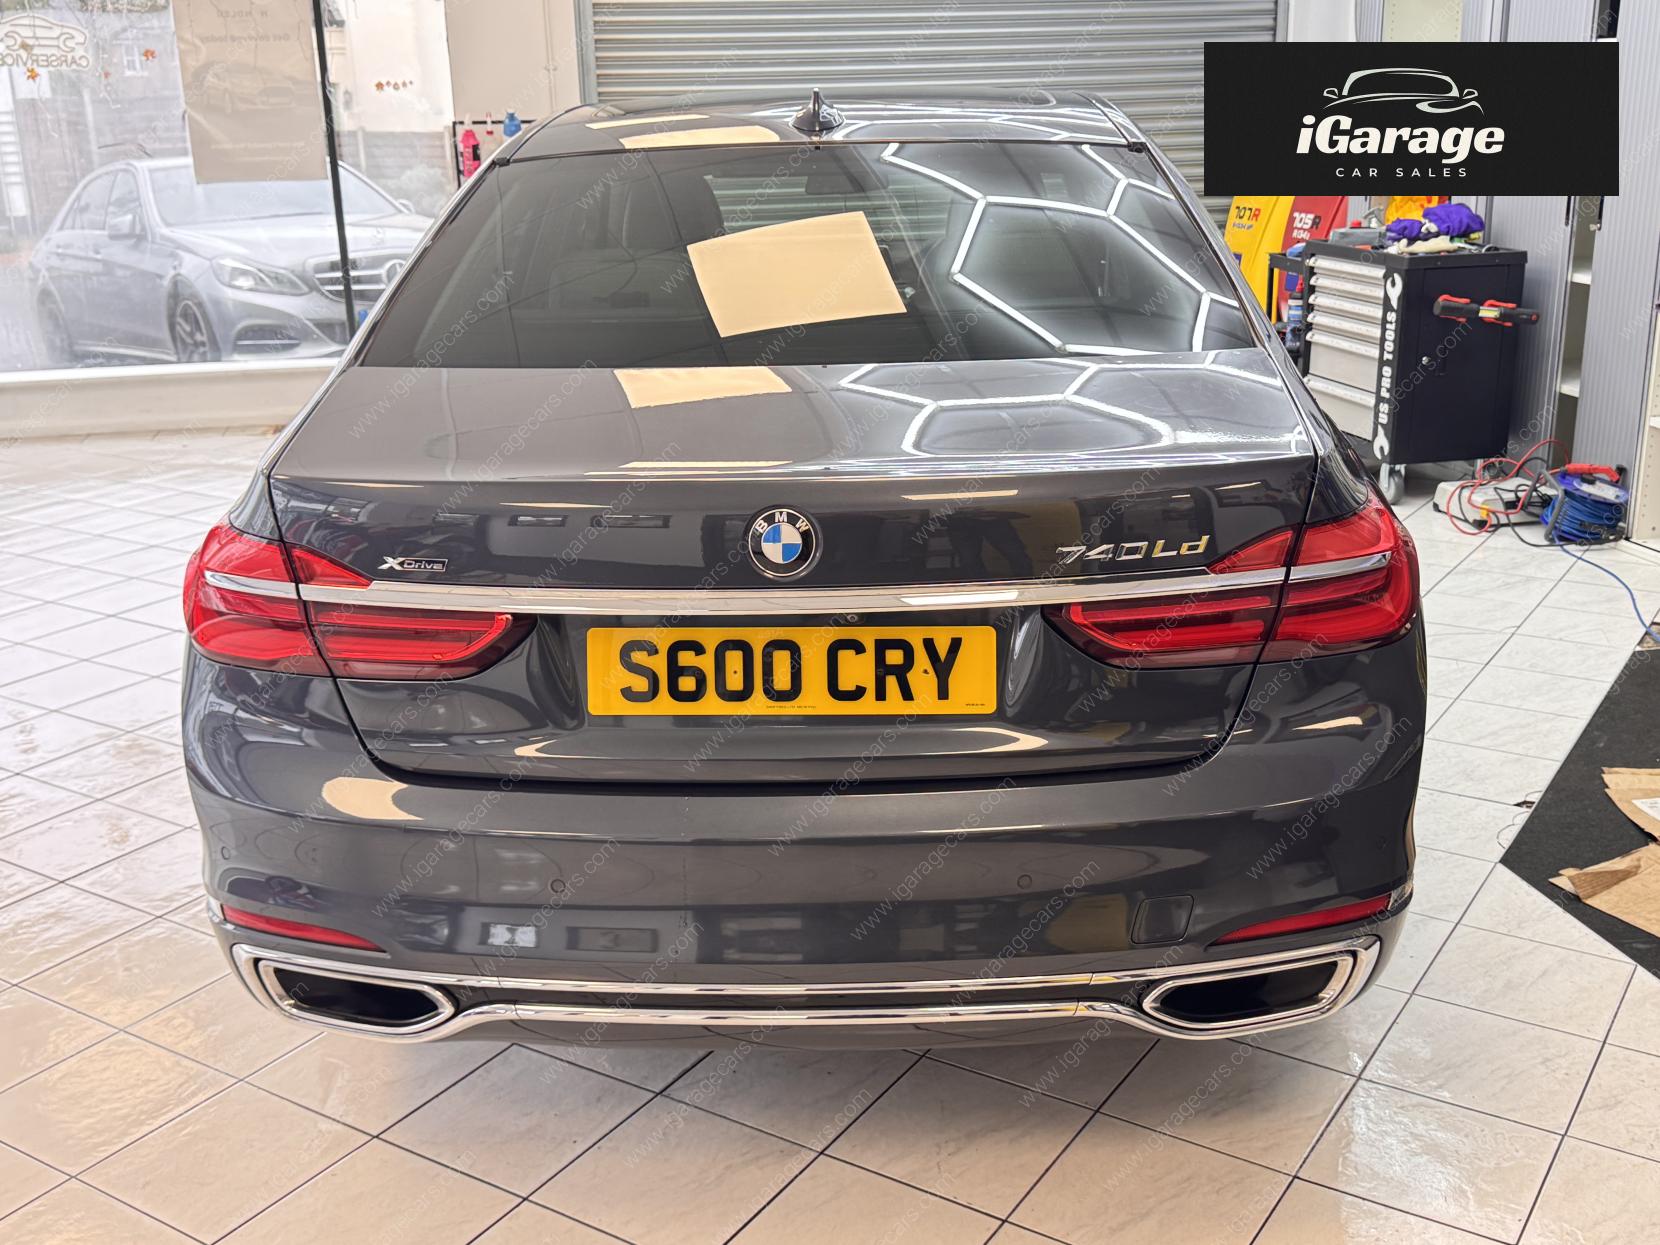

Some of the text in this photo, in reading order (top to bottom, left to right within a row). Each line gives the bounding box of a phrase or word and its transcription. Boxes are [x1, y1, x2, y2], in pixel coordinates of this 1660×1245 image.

[1378, 311, 1397, 425] US PRO TOOLS
[755, 511, 810, 534] BMW
[619, 637, 963, 702] S600 CRY
